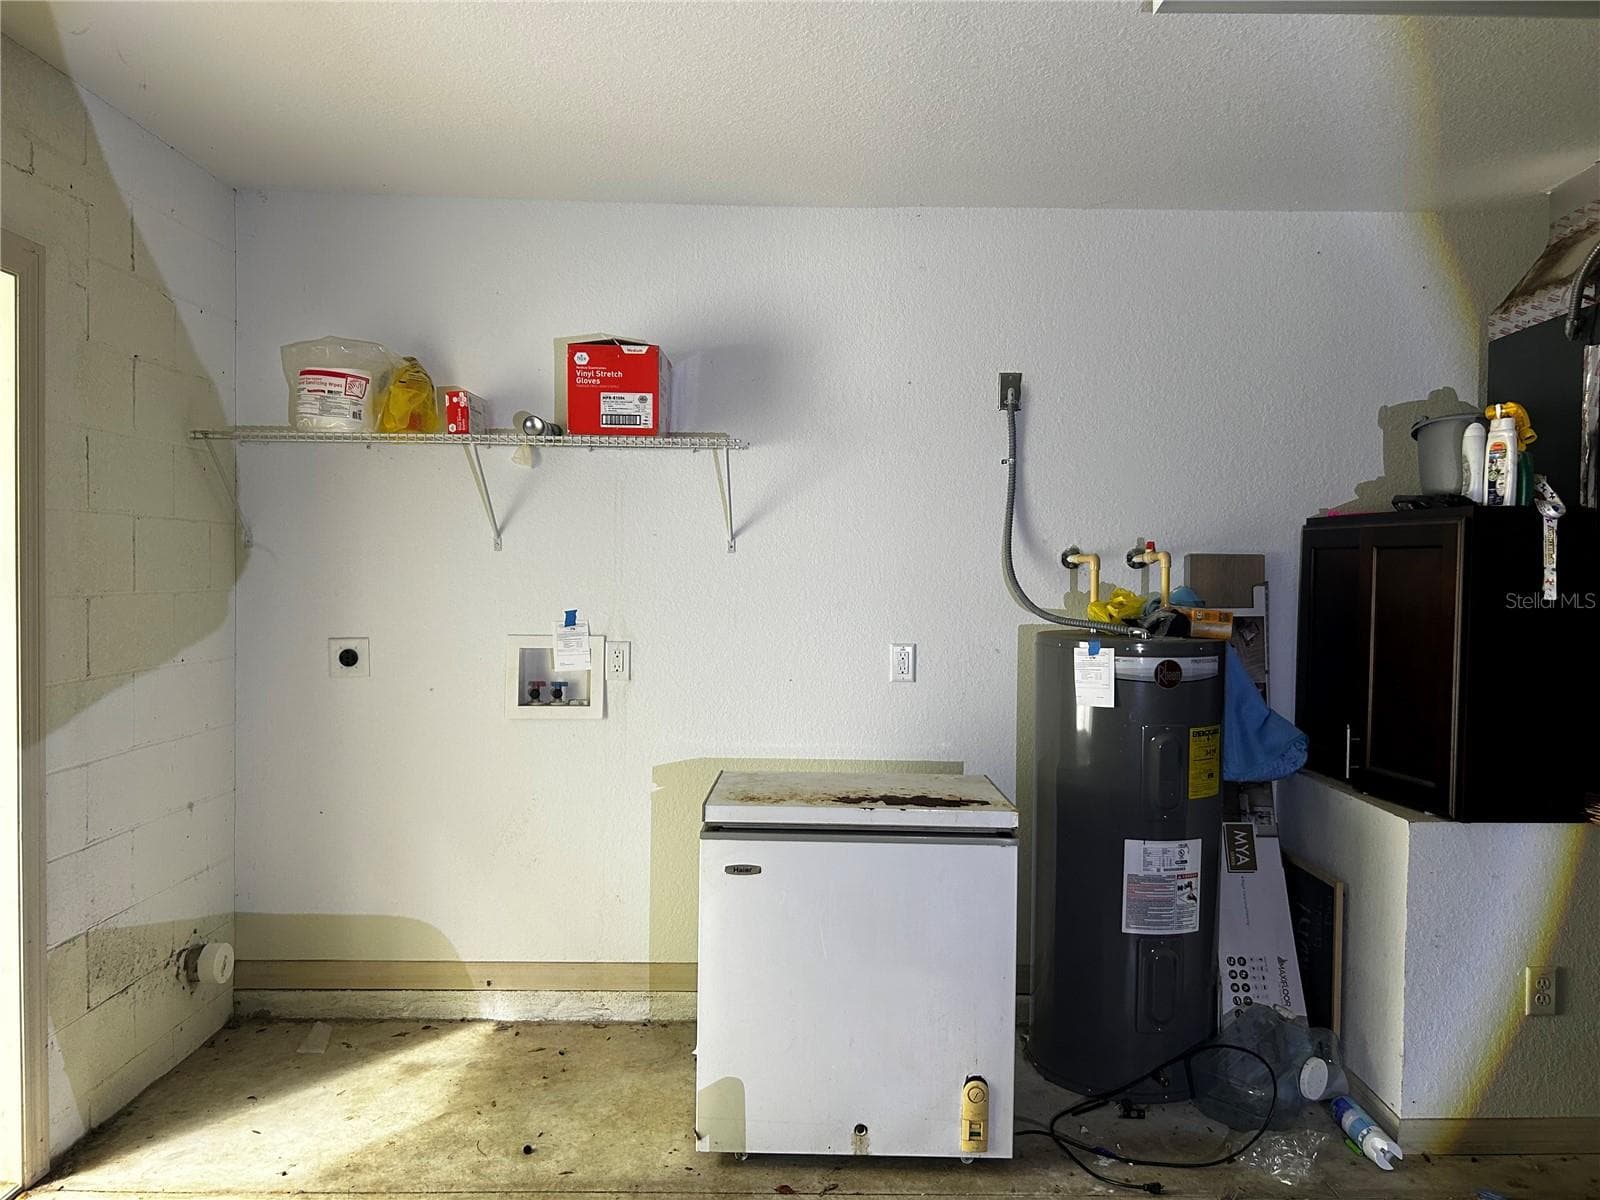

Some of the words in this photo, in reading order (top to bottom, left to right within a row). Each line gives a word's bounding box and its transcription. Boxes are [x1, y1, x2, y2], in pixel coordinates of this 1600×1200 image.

[576, 370, 594, 378] Vinyl
[596, 370, 623, 378] Stretch
[576, 377, 601, 385] Gloves
[1233, 830, 1250, 866] MYA
